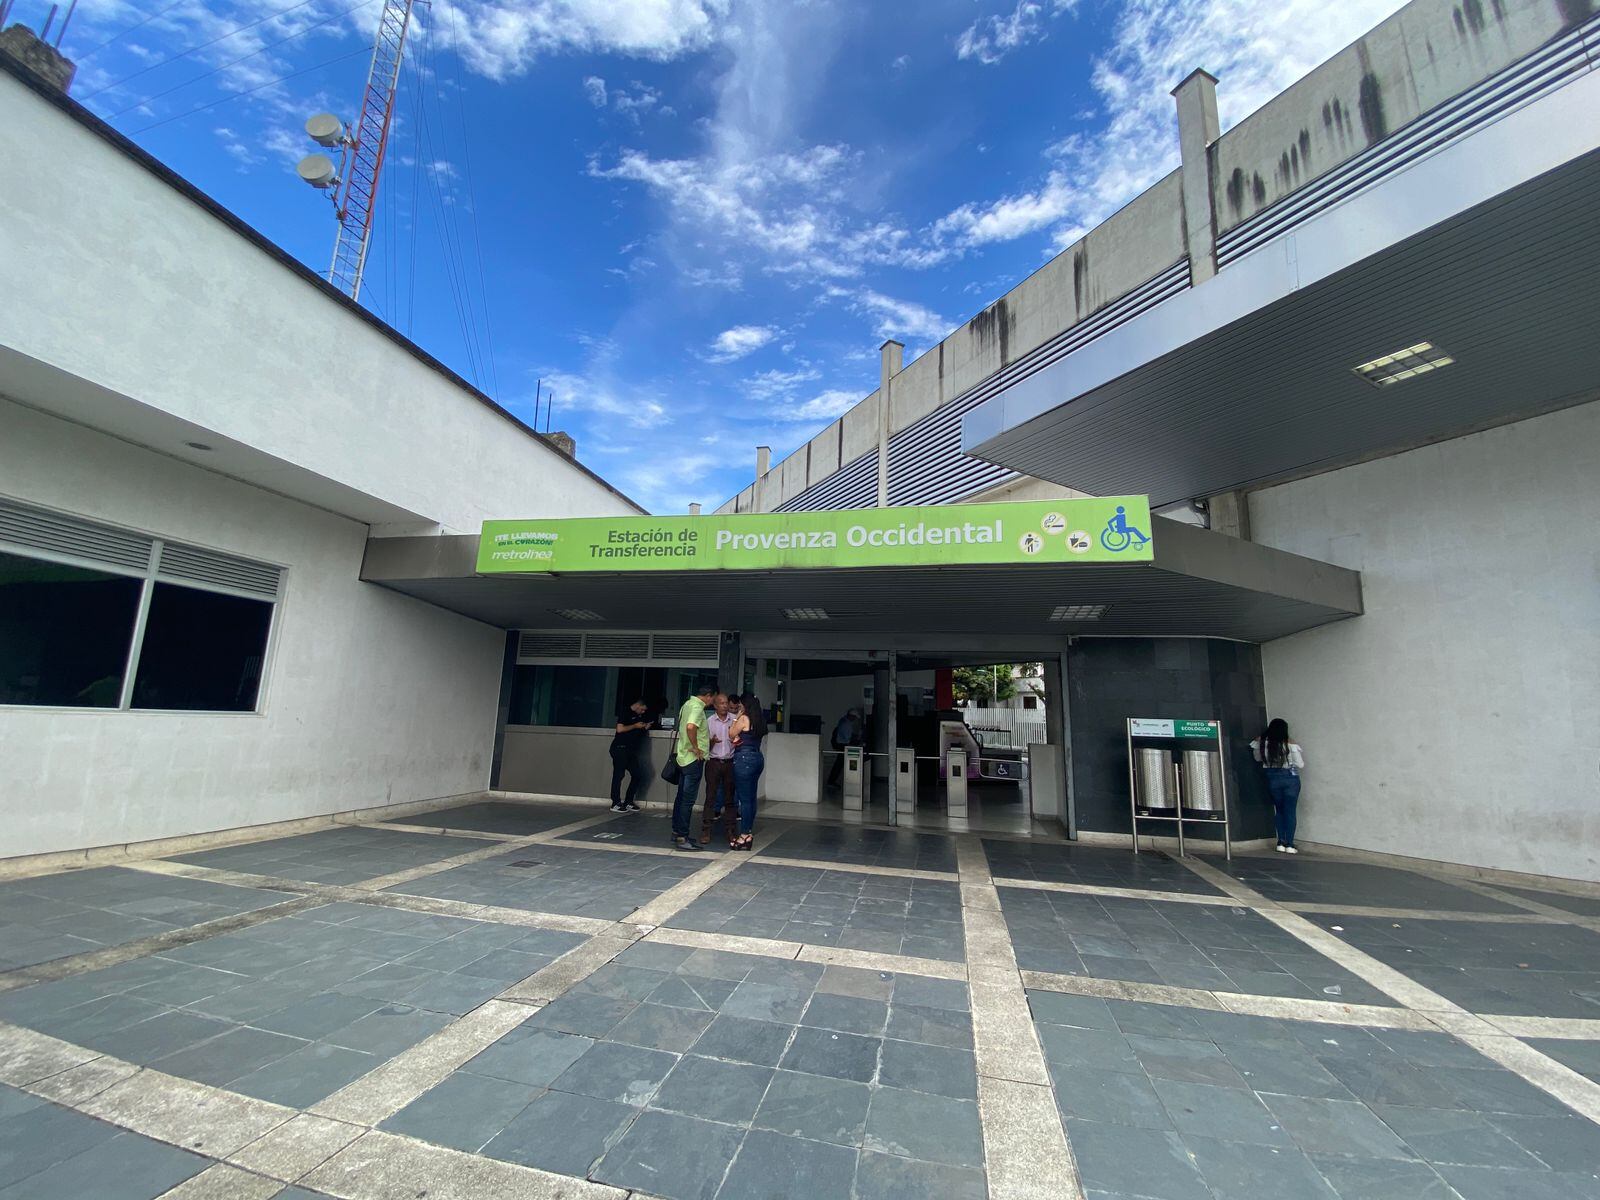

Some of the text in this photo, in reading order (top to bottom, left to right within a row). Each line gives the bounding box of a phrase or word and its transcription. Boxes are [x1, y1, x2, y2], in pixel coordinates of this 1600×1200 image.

[608, 528, 698, 543] Estación de
[716, 520, 1003, 550] Provenza Occidental
[589, 543, 697, 558] Transferencia
